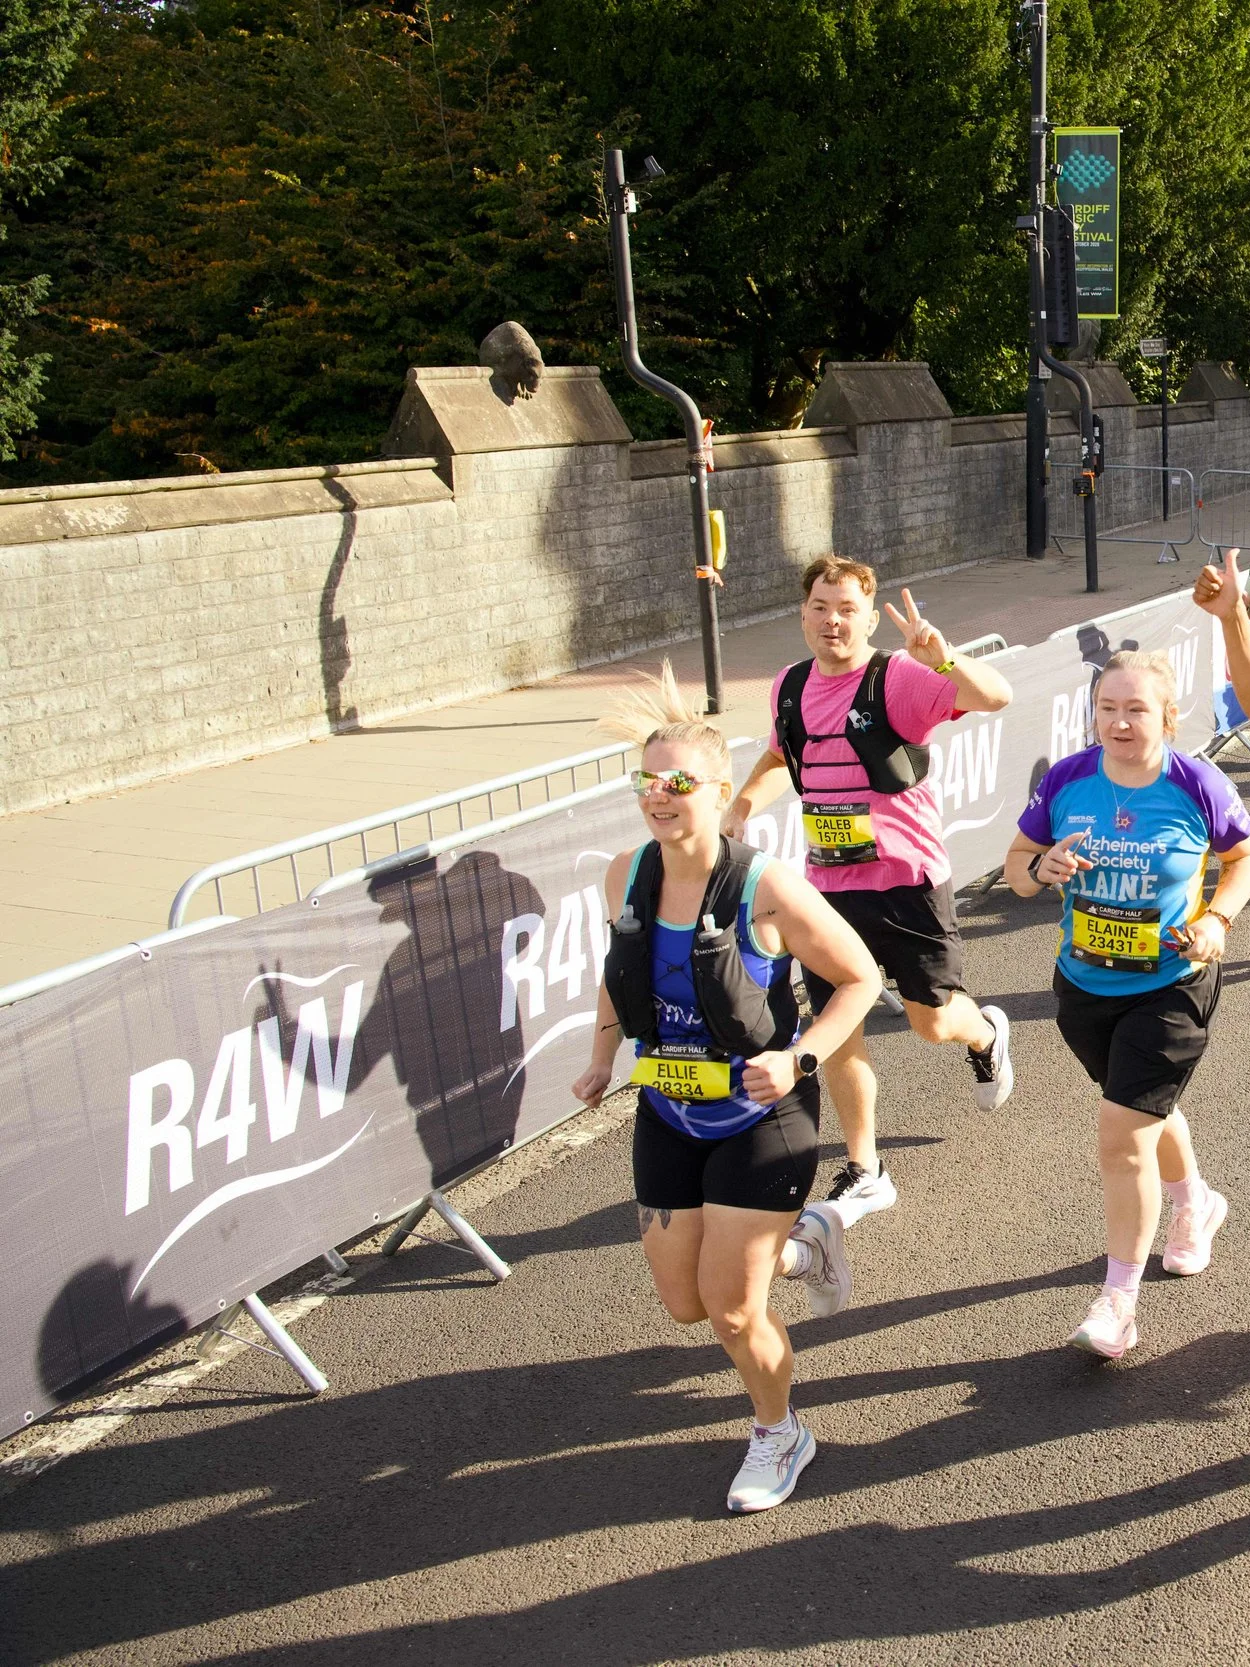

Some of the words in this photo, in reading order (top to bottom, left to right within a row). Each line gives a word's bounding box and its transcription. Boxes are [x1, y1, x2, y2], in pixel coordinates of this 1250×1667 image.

[1075, 204, 1110, 214] RDIFF
[1075, 214, 1095, 223] SIC
[1074, 232, 1114, 242] STIVAL
[1050, 682, 1094, 762] R4
[815, 818, 852, 830] CALEB
[817, 831, 852, 843] 15731
[1081, 834, 1167, 855] Alzheimer's
[1089, 851, 1150, 874] Society
[1099, 906, 1125, 916] CARDIFF
[1087, 919, 1139, 939] ELAINE
[1088, 934, 1132, 953] 23431
[662, 1044, 687, 1054] CARDIFF
[657, 1063, 698, 1080] ELLIE
[125, 980, 363, 1215] R4W
